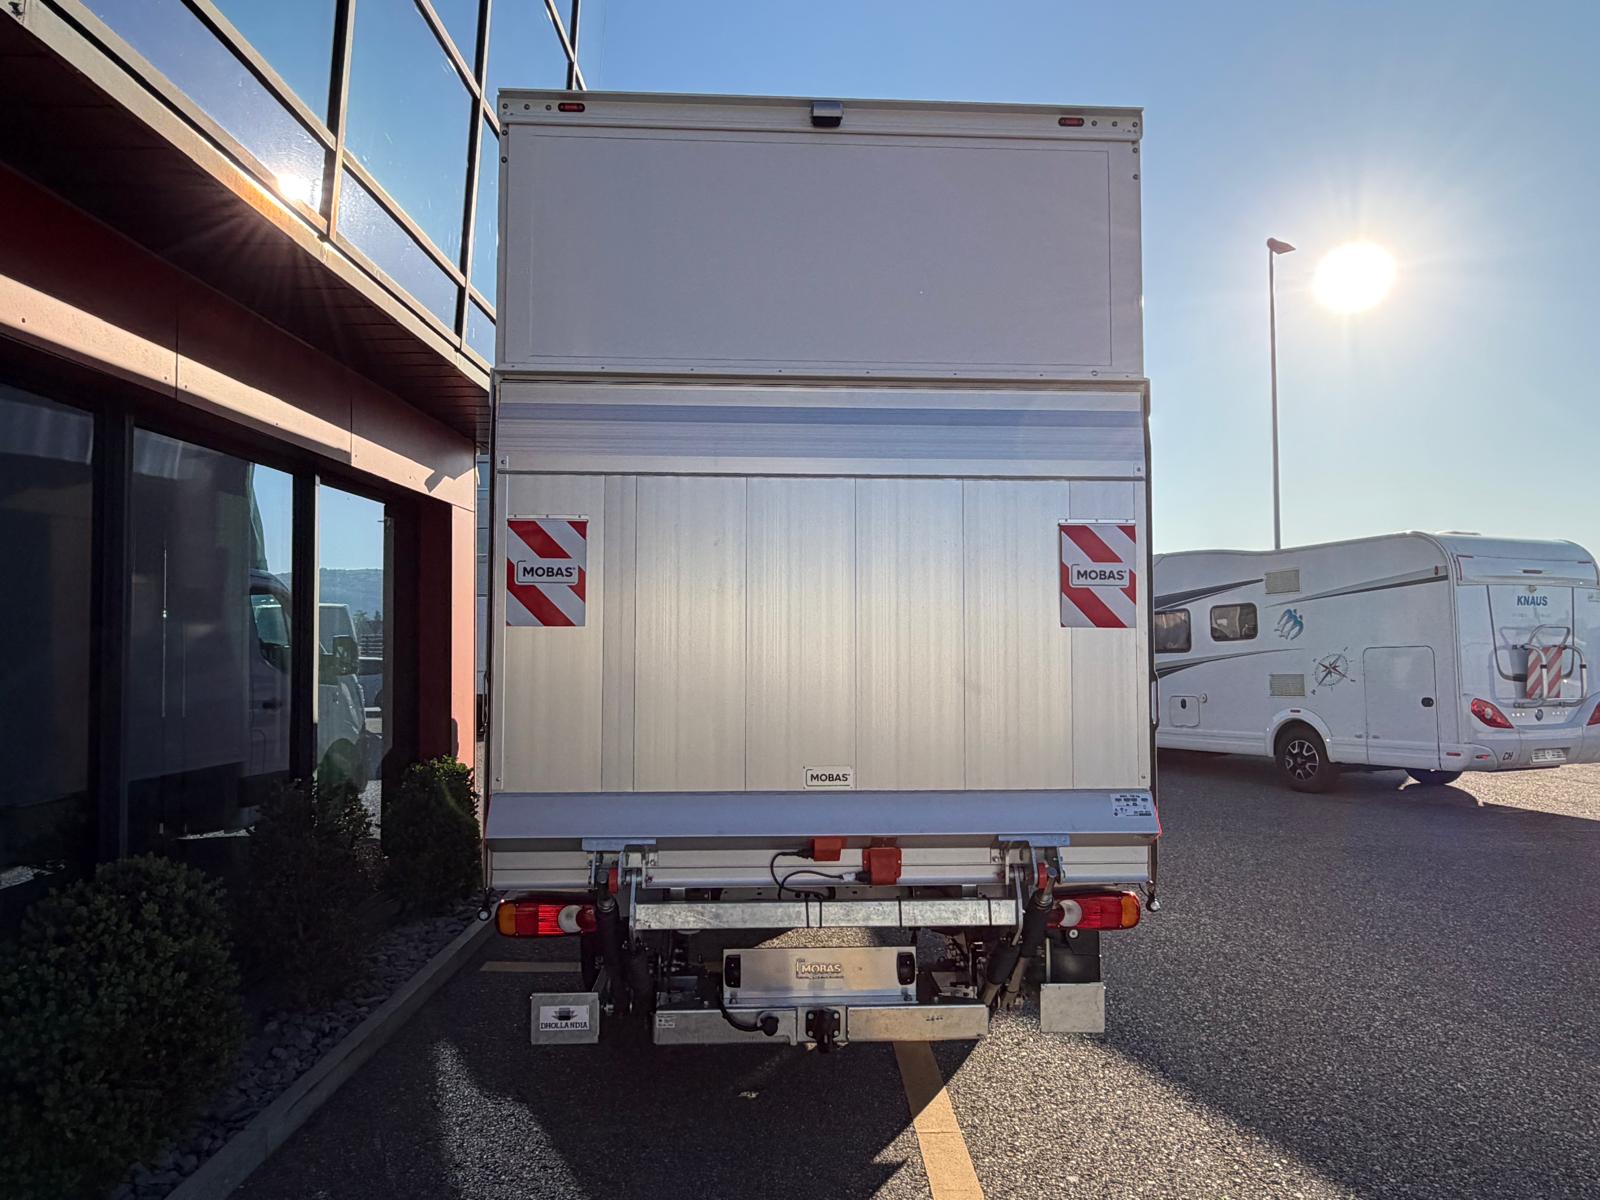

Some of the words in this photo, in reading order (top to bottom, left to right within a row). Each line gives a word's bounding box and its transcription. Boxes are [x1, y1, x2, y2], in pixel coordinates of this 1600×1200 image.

[522, 566, 574, 578] MOBAS
[1076, 570, 1125, 581] MOBAS
[1517, 595, 1548, 606] KNAUS
[810, 773, 849, 782] MOBAS
[540, 1021, 588, 1030] DHOLLANDIA
